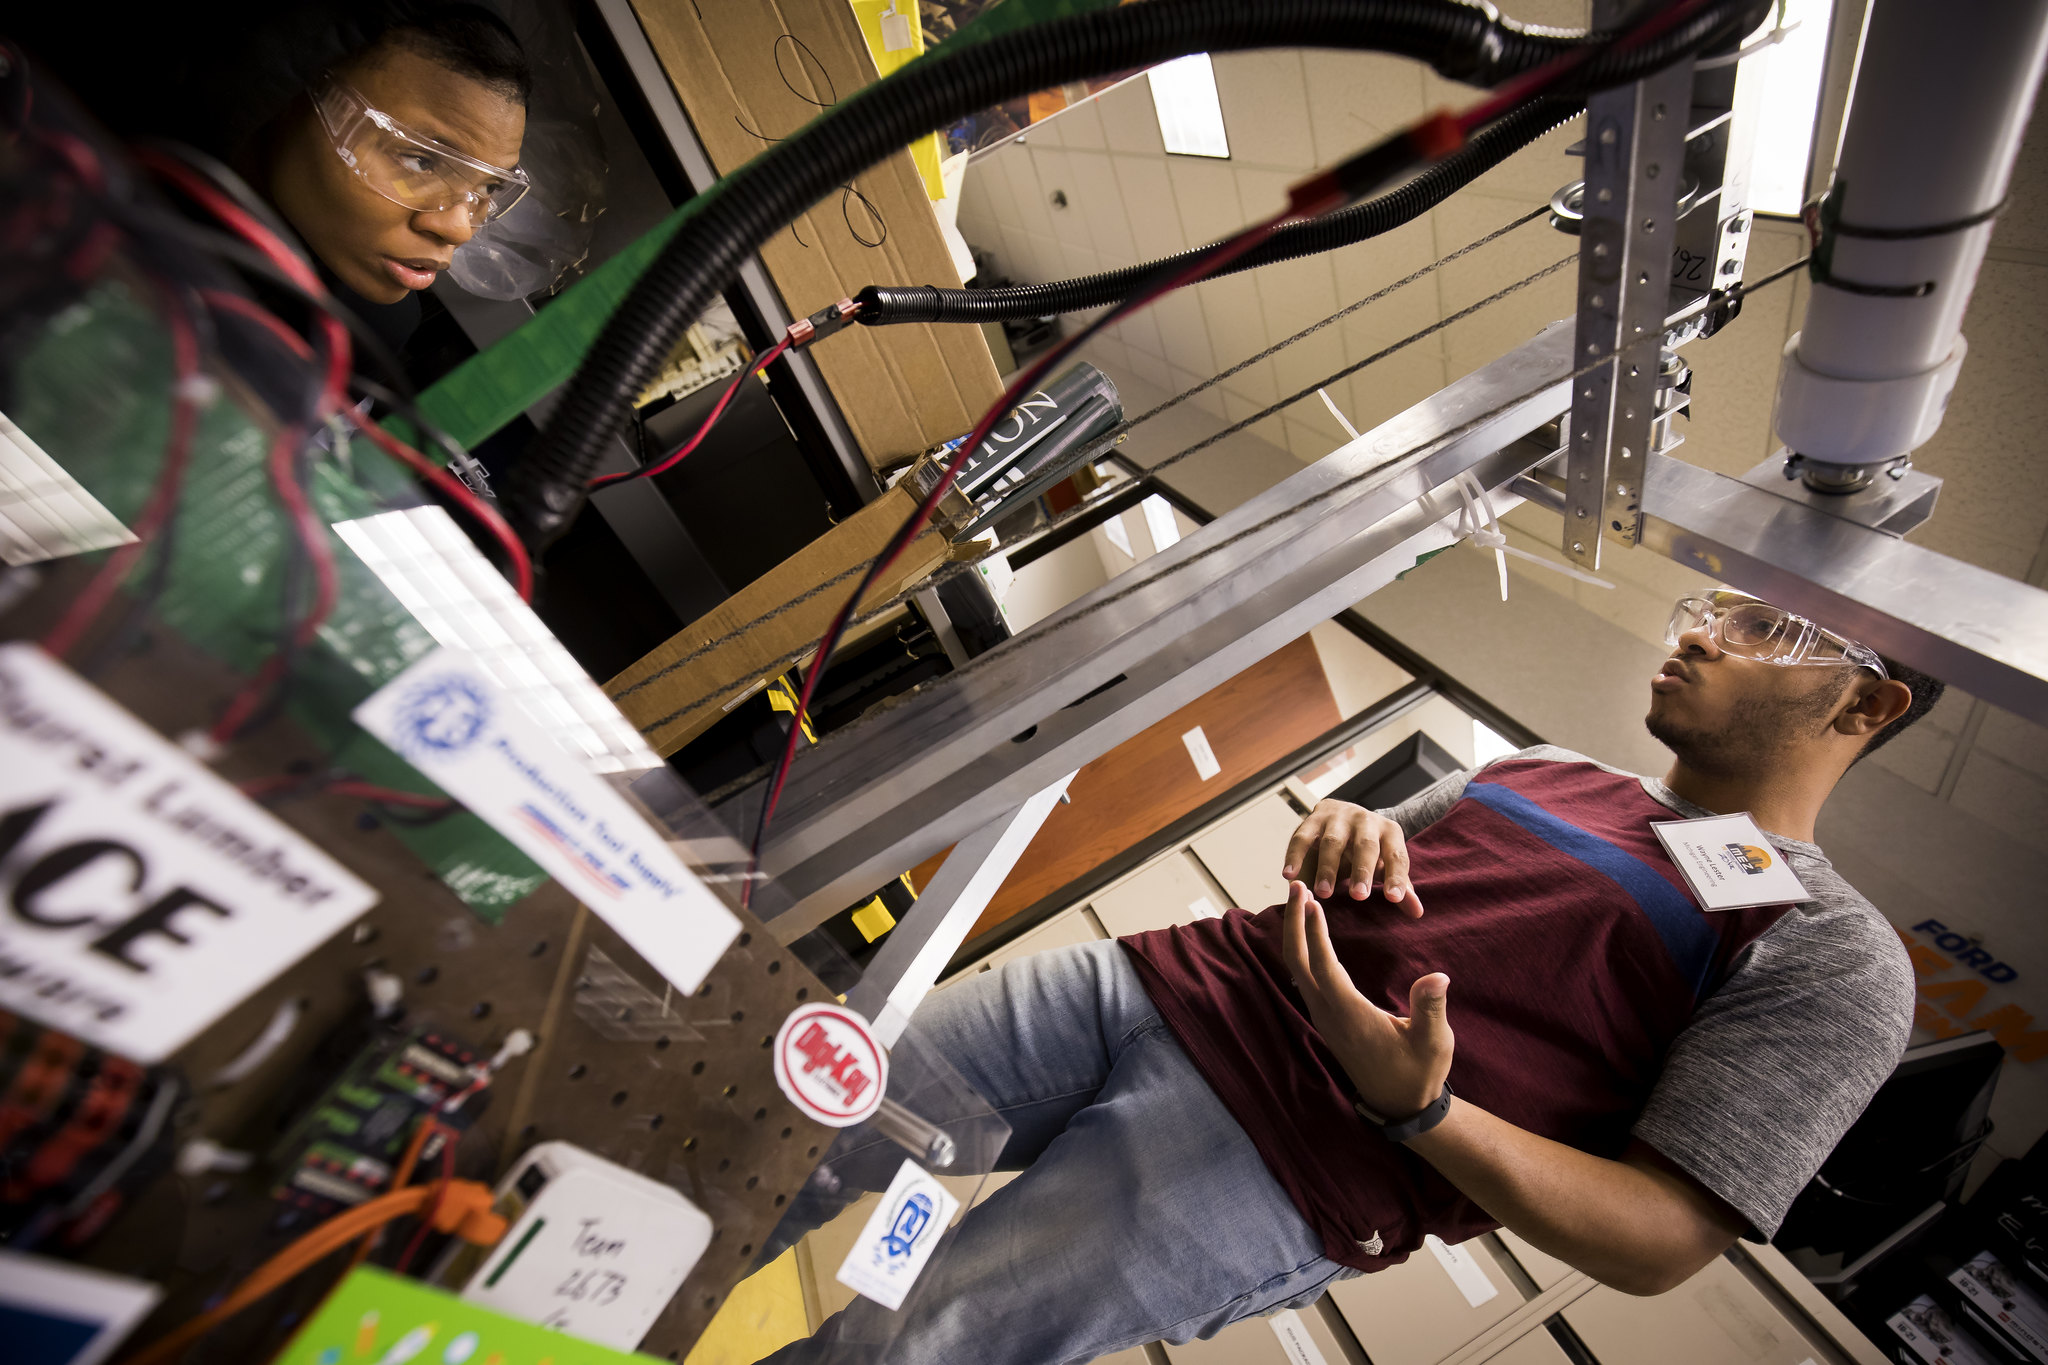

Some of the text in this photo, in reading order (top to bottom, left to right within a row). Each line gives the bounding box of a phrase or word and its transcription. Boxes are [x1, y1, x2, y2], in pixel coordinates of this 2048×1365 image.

[140, 778, 337, 912] Lumber
[1696, 844, 1726, 881] Wayne Lester
[1730, 847, 1754, 870] MEZ
[1911, 918, 2019, 984] FORD
[1892, 924, 2048, 1065] EAM
[570, 1215, 627, 1259] Team
[553, 1267, 628, 1307] 2673
